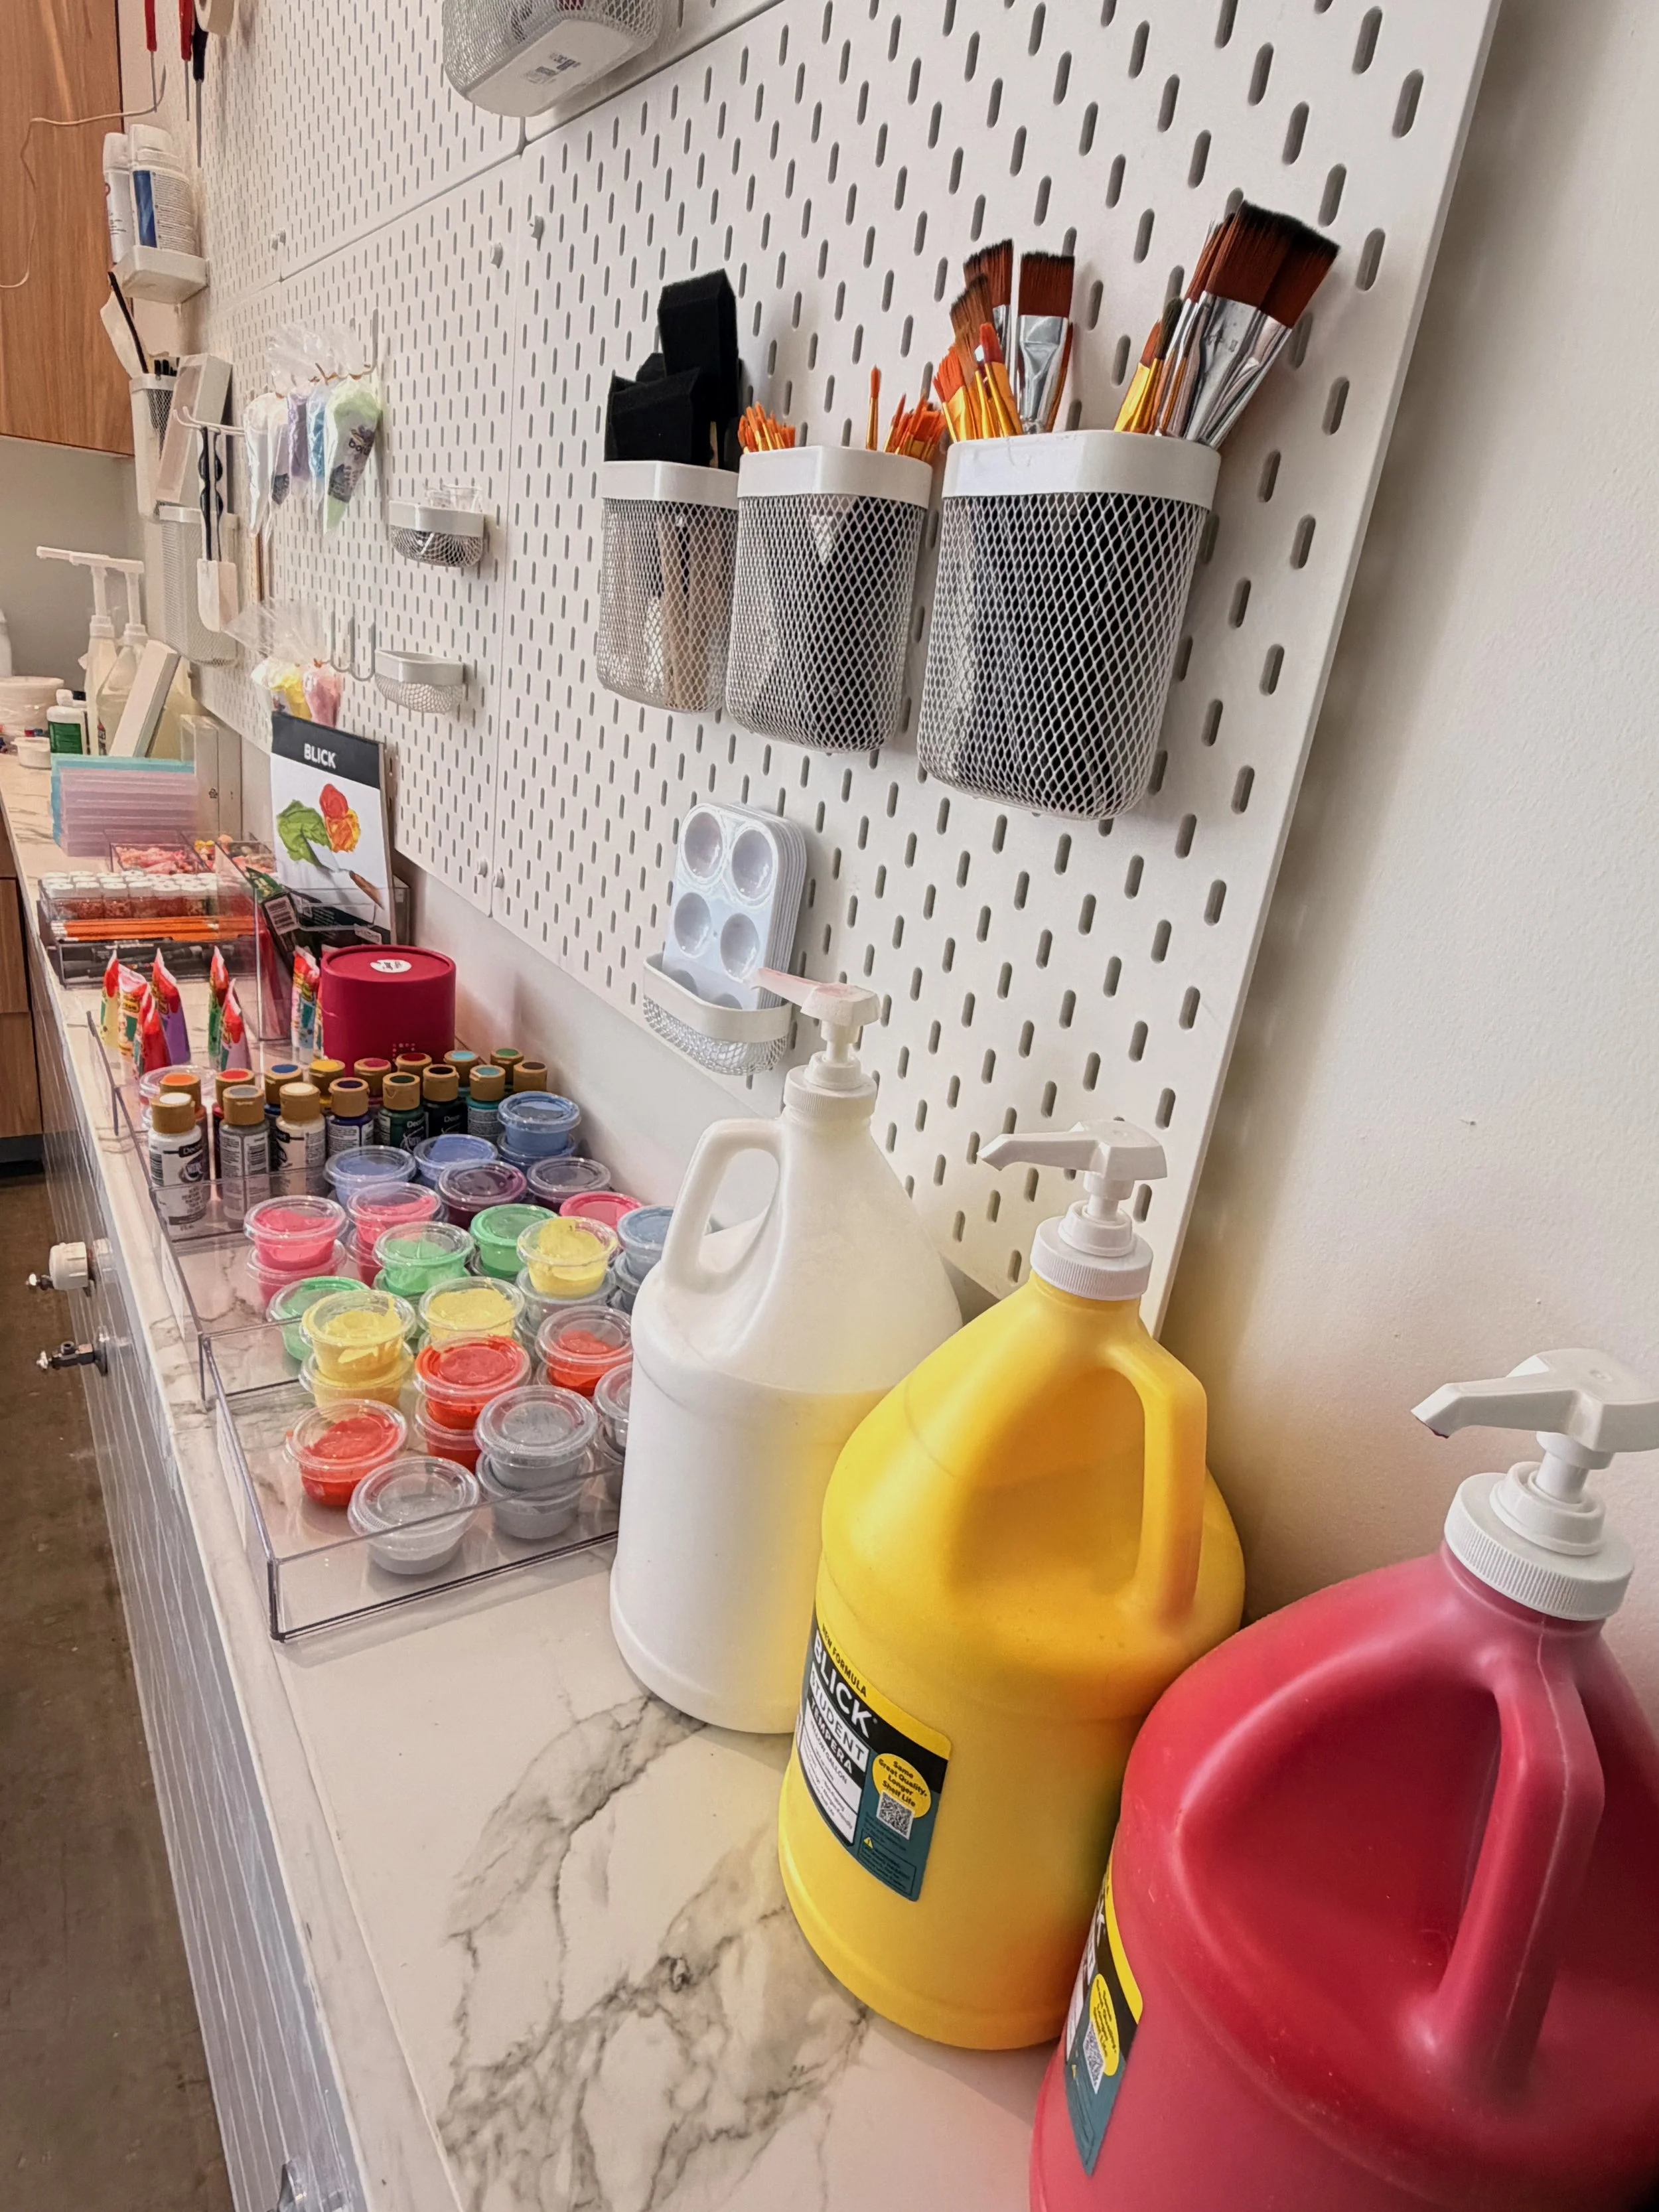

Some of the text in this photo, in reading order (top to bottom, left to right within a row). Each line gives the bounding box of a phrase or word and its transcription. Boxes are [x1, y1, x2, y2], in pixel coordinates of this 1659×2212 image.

[304, 743, 336, 769] BLICK
[814, 1629, 872, 1739] BLICK
[832, 1647, 867, 1698] FORMULA
[812, 1669, 865, 1761] STUDENT
[810, 1696, 853, 1775] TEMPERA
[878, 1758, 898, 1778] Great
[893, 1760, 914, 1779] Same
[882, 1780, 916, 1807] Shelf Life
[888, 1774, 914, 1796] Longer
